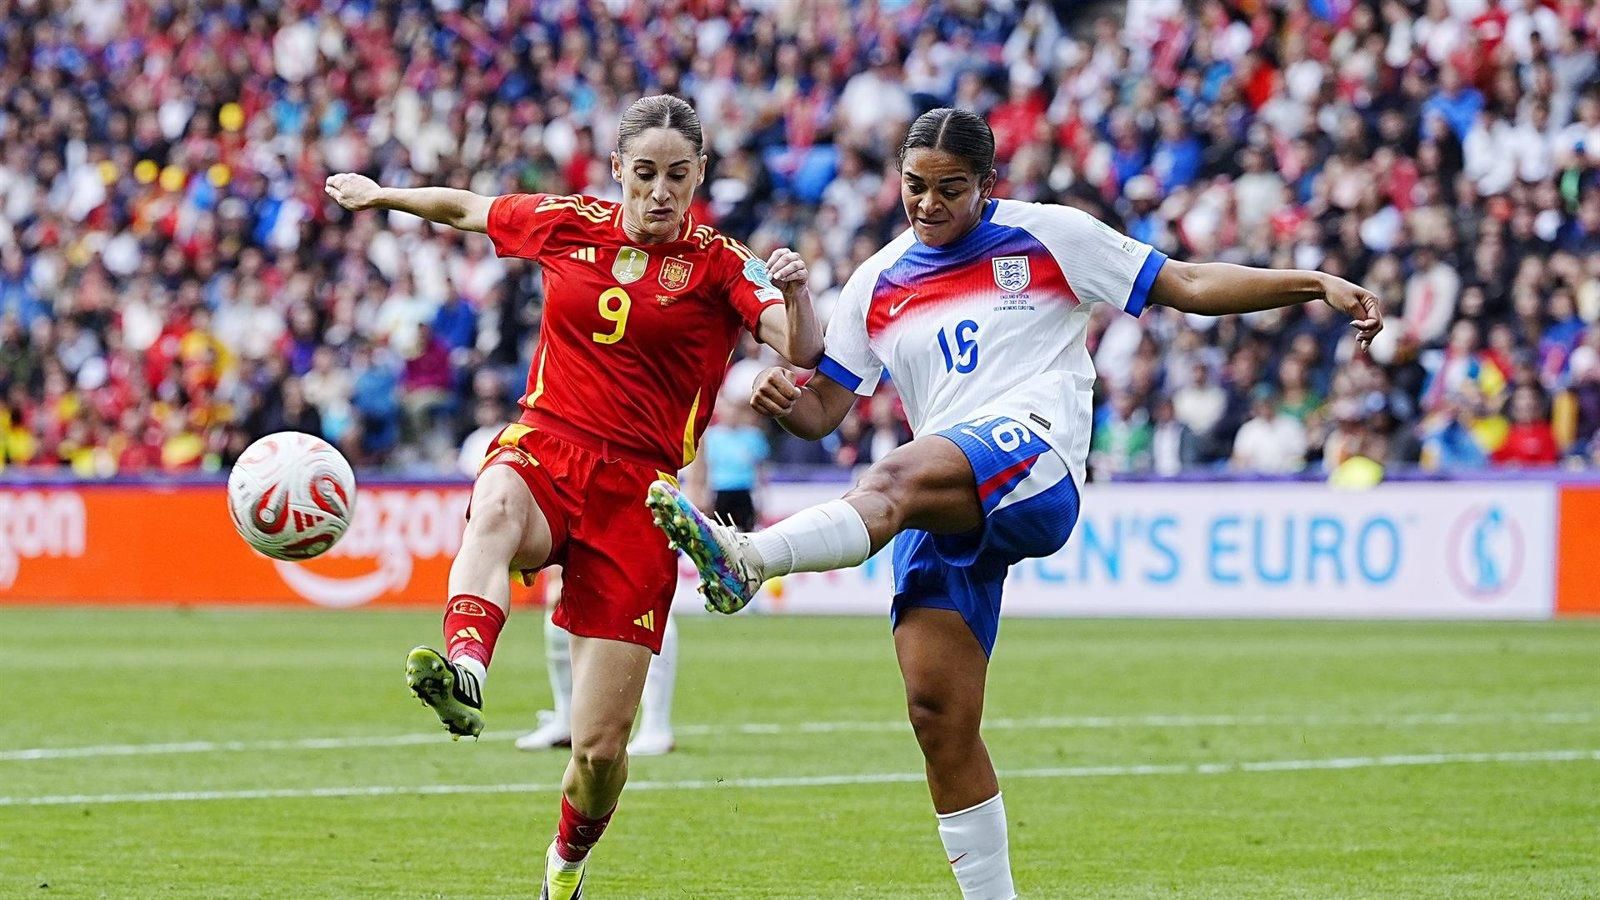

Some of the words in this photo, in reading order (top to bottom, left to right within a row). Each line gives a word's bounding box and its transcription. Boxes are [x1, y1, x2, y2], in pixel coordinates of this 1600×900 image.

[592, 286, 631, 344] 9
[937, 319, 979, 374] 16
[1207, 513, 1402, 586] EURO
